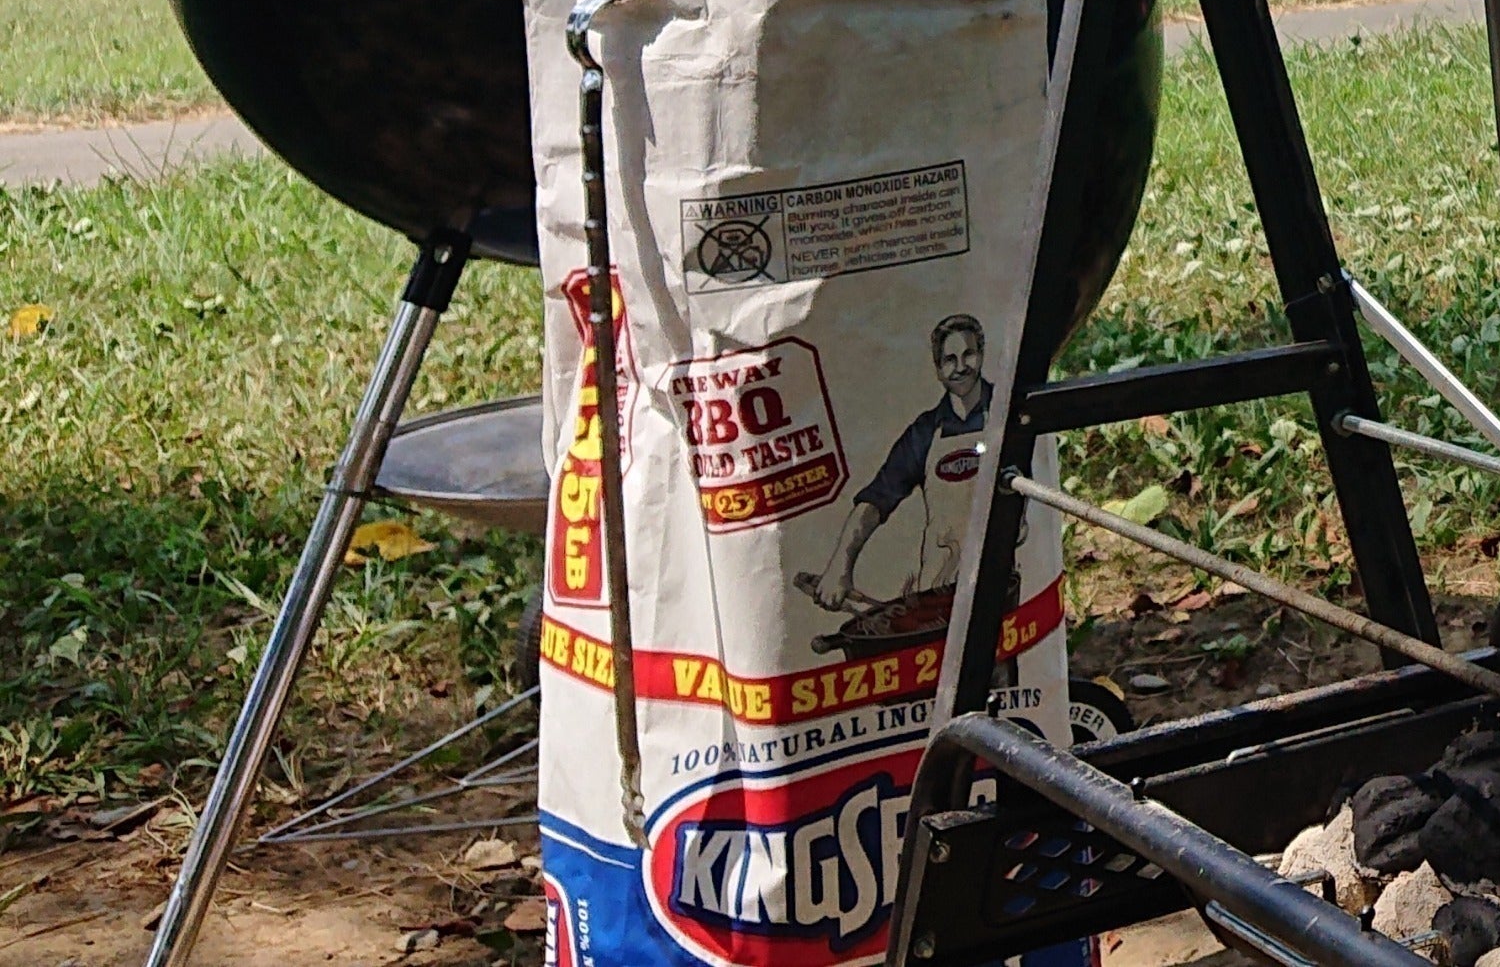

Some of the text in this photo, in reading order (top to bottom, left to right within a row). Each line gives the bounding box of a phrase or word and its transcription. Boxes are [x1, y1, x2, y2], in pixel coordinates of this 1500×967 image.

[699, 195, 778, 219] WARNING
[787, 167, 959, 208] CARBON MONOXIDE HAZARD
[788, 186, 960, 223] Burning charcoal inside can
[789, 222, 806, 234] kill
[842, 216, 850, 228] It
[852, 211, 887, 228] gives
[888, 205, 906, 219] off
[909, 200, 951, 215] carbon
[920, 213, 936, 224] no
[791, 247, 840, 262] NEVER
[872, 233, 928, 251] charcoal
[672, 357, 783, 396] THE WAY
[683, 386, 792, 446] BBQ
[742, 424, 824, 473] TASTE
[762, 465, 829, 500] FASTER
[791, 657, 900, 715] SIZE
[671, 743, 736, 775] 100%
[738, 716, 867, 764] NATURAL
[577, 899, 590, 951] 100%
